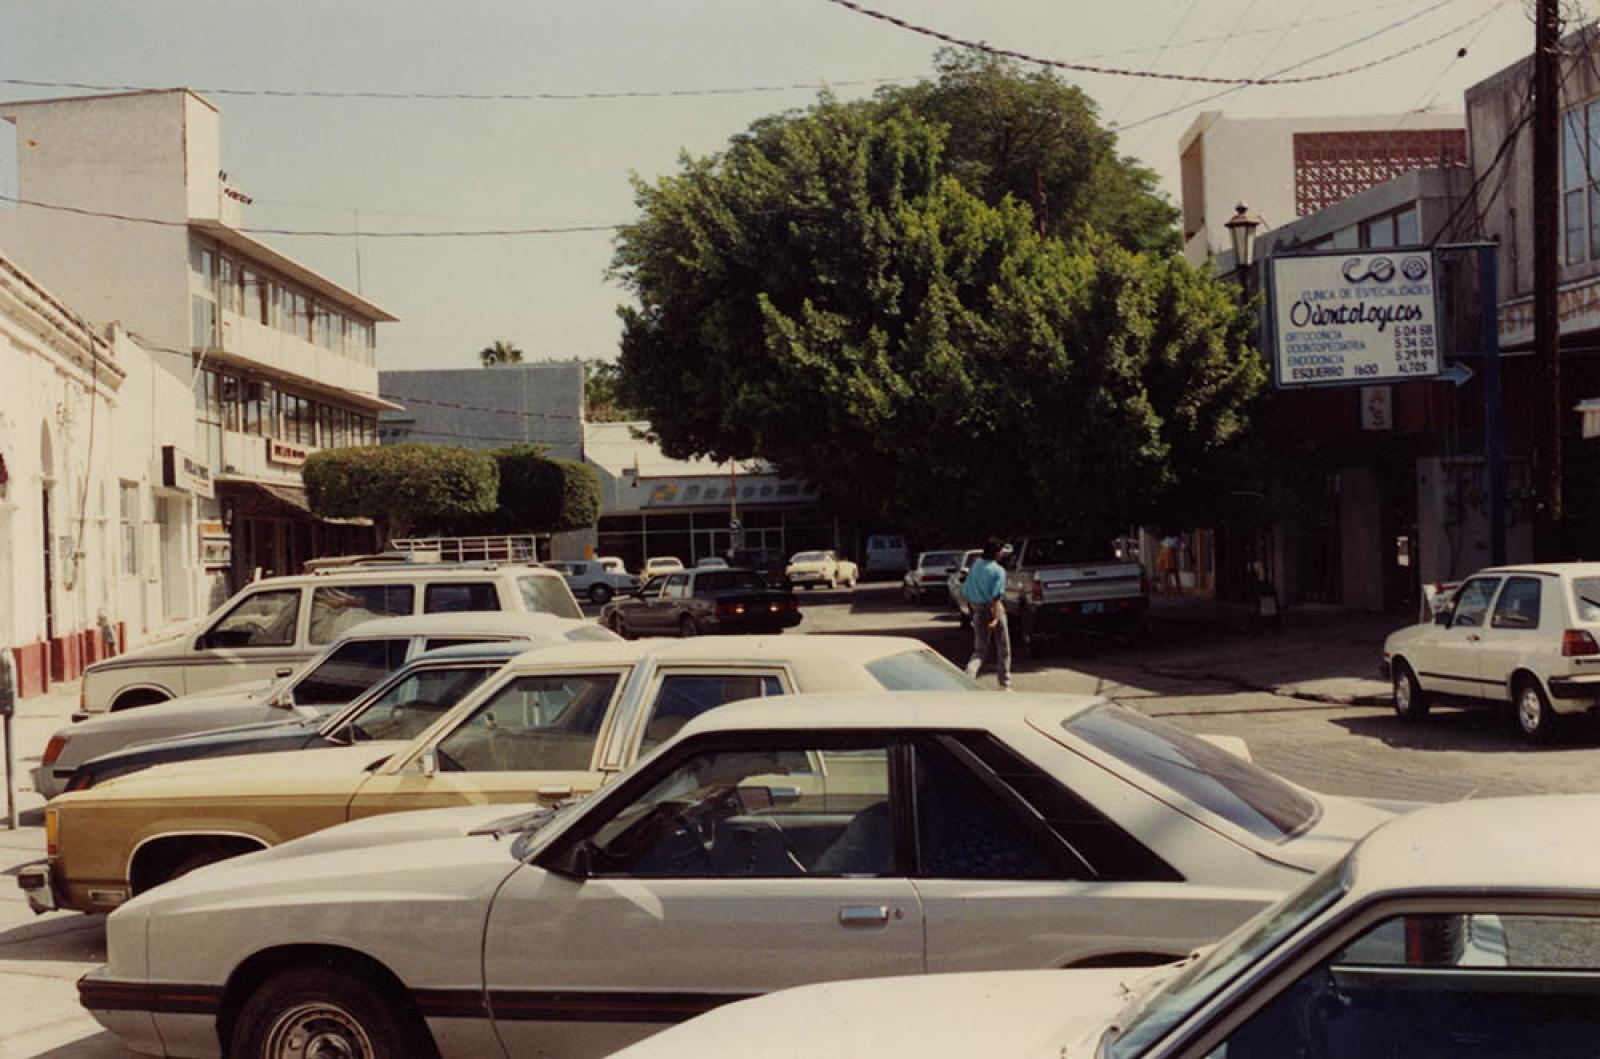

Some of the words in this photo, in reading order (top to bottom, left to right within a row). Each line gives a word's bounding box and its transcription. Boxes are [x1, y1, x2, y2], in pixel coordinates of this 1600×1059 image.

[1301, 290, 1336, 301] CLINICA
[1339, 288, 1353, 299] DE
[1292, 366, 1344, 379] ESQUERRO
[1398, 362, 1428, 373] ALTOS
